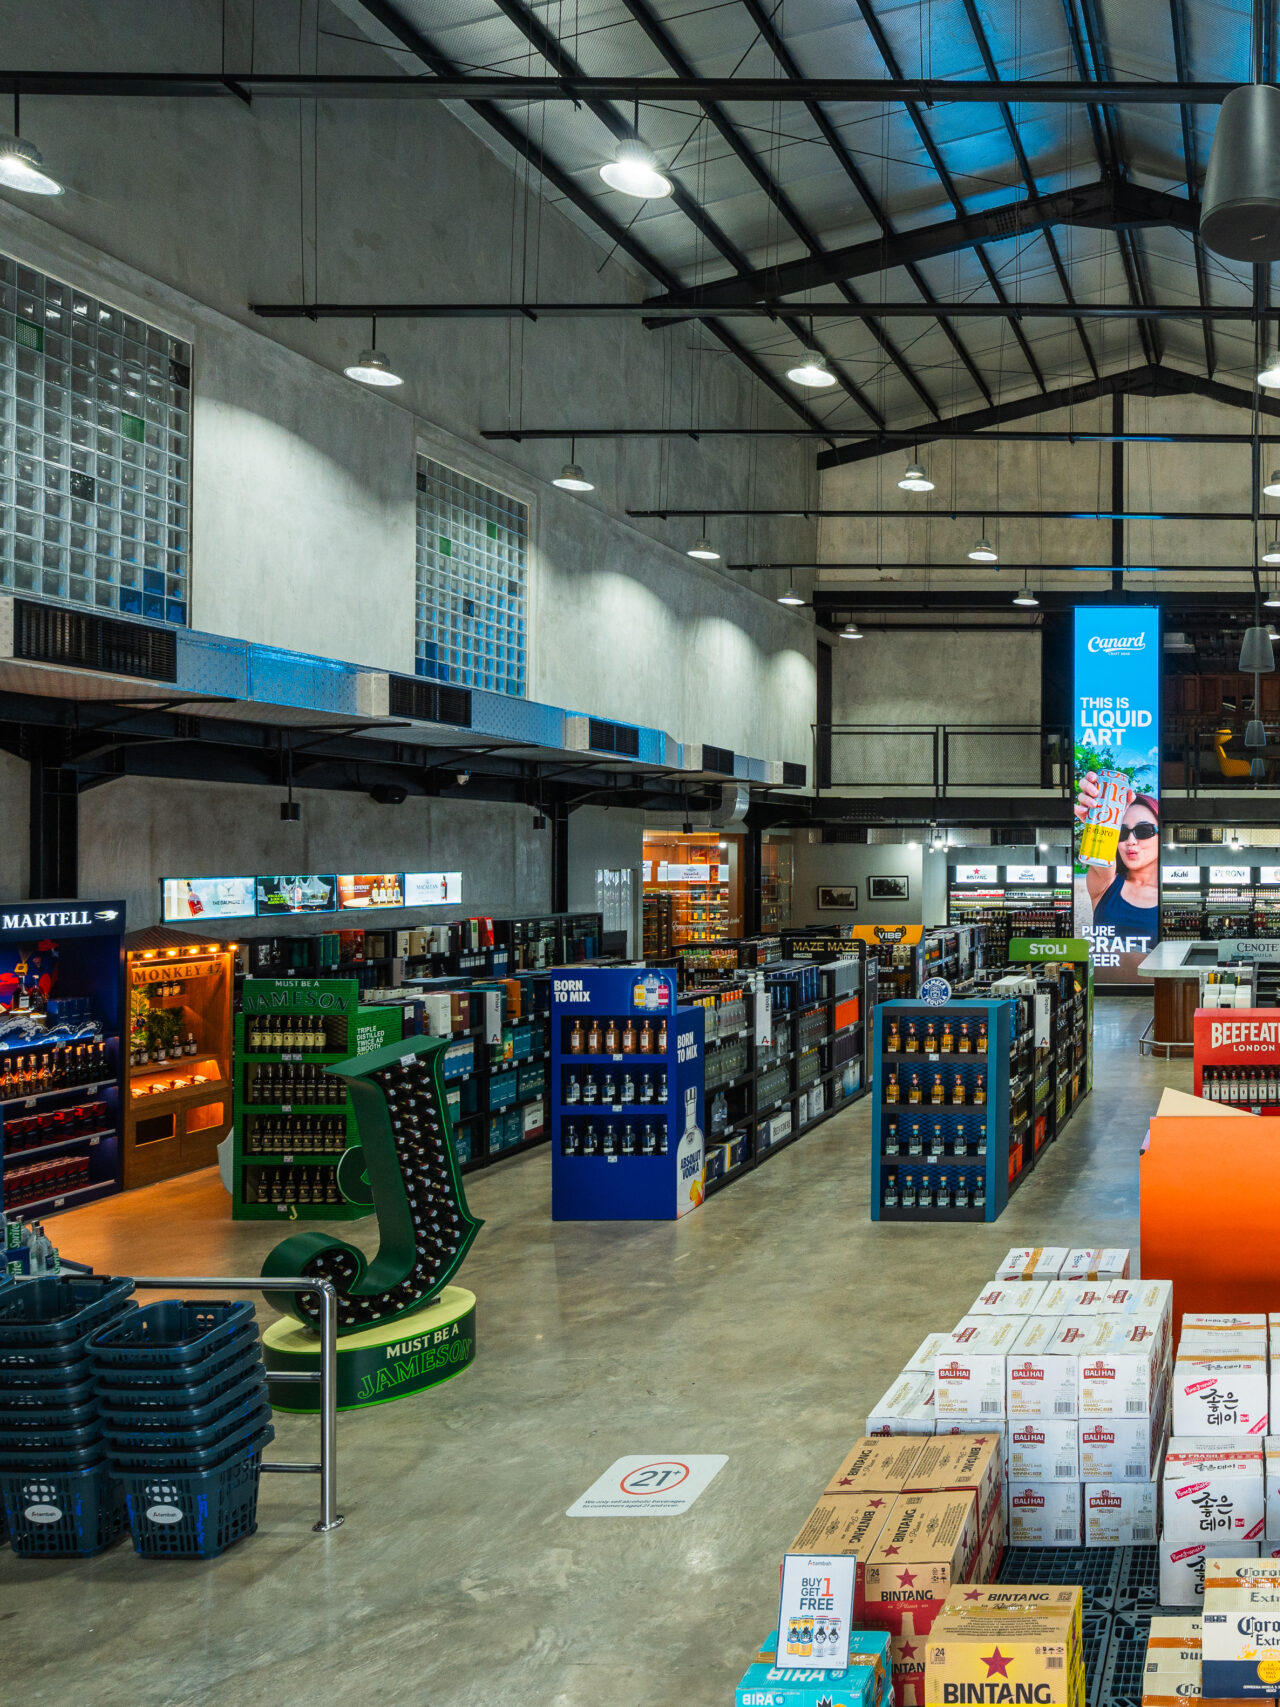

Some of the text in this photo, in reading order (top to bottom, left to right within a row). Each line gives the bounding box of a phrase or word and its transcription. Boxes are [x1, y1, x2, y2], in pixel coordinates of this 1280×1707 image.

[1087, 632, 1146, 653] Canard
[1080, 697, 1129, 709] THIS IS
[1080, 710, 1152, 729] LIQUID
[1081, 728, 1126, 746] ART
[2, 911, 92, 929] MARTELL
[1081, 925, 1115, 936] PURE
[793, 942, 860, 951] MAZE MAZE
[1029, 943, 1067, 955] STOLI
[1085, 936, 1151, 953] CRAFT
[1236, 942, 1278, 952] CENOTE
[1089, 954, 1120, 967] EER
[134, 963, 222, 983] MONKEY 47
[553, 979, 583, 991] BORN
[923, 977, 946, 990] OLMECA
[243, 989, 350, 1013] JAMESON
[554, 991, 591, 1003] TO MIX
[924, 994, 947, 1007] TEQUILA
[356, 1030, 385, 1040] DISTILLED
[357, 1025, 377, 1034] TRIPLE
[357, 1038, 375, 1047] TWICE
[677, 1031, 694, 1049] BORN
[357, 1043, 381, 1052] SMOOTH
[677, 1044, 698, 1064] TO MIX
[1233, 1044, 1275, 1052] LONDON
[773, 1119, 791, 1137] BELVEDERE
[680, 1148, 701, 1170] ABSOLUT
[682, 1162, 700, 1180] VODKA
[10, 1222, 22, 1248] Sprite
[386, 1322, 459, 1359] MUST BE A
[357, 1337, 473, 1399] JAMESON
[1013, 1370, 1044, 1378] BALI HAI
[1200, 1388, 1239, 1413] 좋은
[1207, 1410, 1237, 1426] 데이
[848, 1449, 872, 1476] BINTANG
[962, 1447, 981, 1473] BINTANG
[1192, 1492, 1233, 1517] 좋은
[849, 1510, 875, 1543] BINTANG
[892, 1508, 917, 1543] BINTANG
[1200, 1515, 1232, 1532] 데이
[807, 1559, 832, 1567] Atambah
[870, 1569, 880, 1577] 24
[801, 1578, 822, 1587] BUY
[821, 1577, 834, 1597] 1
[801, 1588, 821, 1597] GET
[881, 1590, 934, 1602] BINTANG
[988, 1593, 1050, 1601] BINTANG
[799, 1598, 834, 1611] FREE
[935, 1648, 945, 1656] 24
[742, 1693, 773, 1706] BIRA
[943, 1683, 1051, 1704] BINTANG
